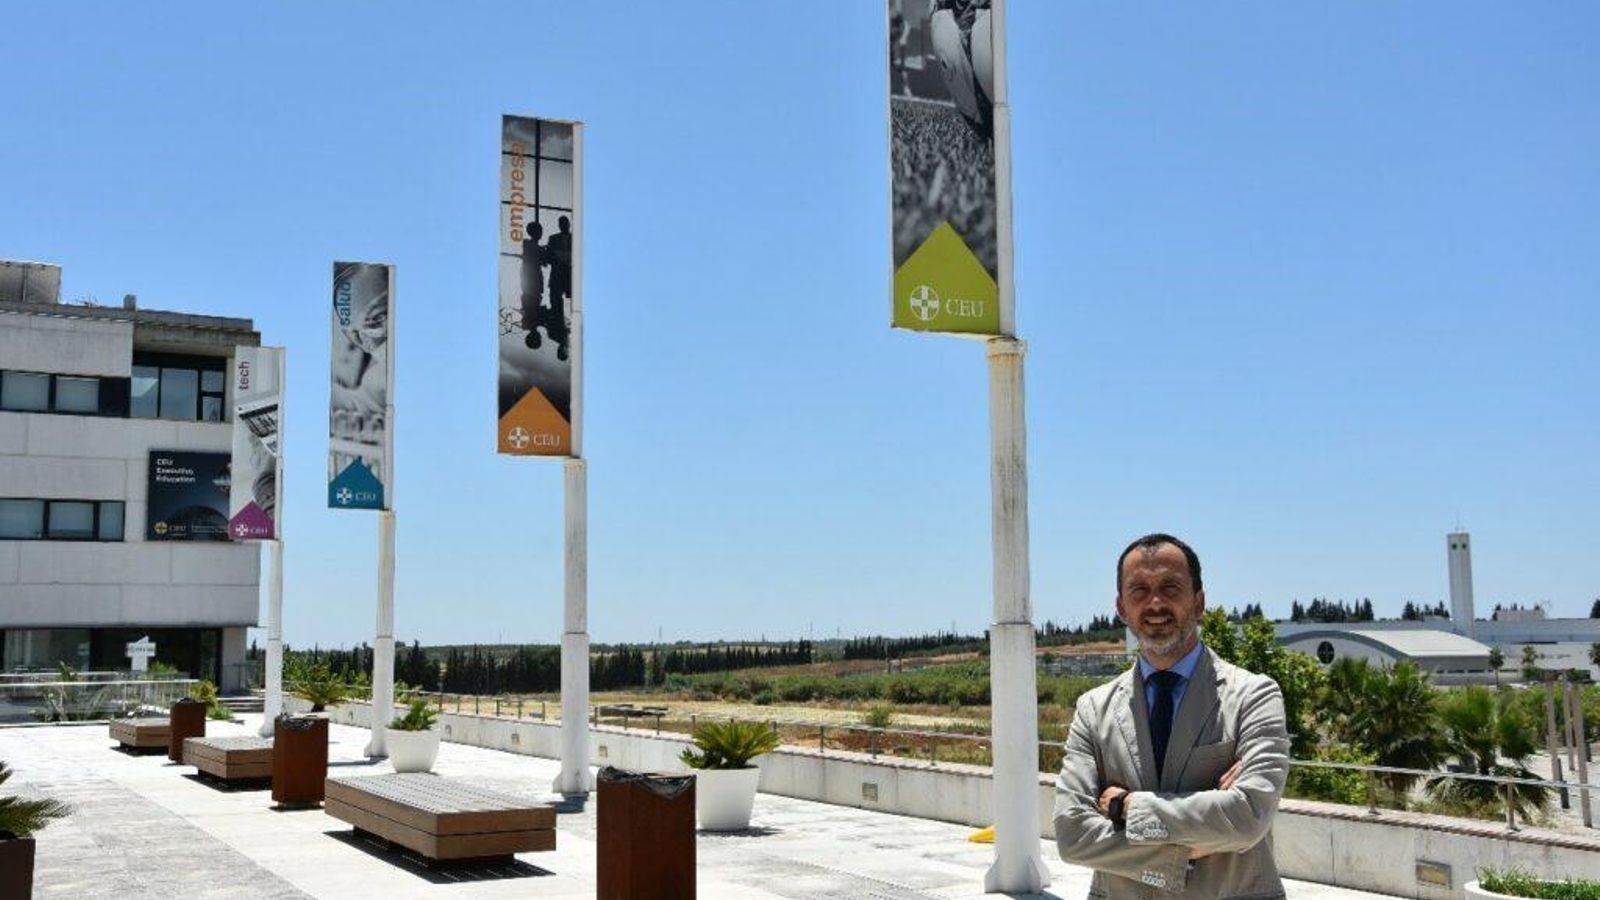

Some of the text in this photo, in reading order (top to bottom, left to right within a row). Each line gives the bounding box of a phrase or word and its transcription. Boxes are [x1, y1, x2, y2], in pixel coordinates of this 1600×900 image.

[510, 143, 526, 242] empresa
[337, 281, 351, 326] salud
[945, 298, 984, 318] CEU
[238, 361, 250, 390] tech
[533, 433, 561, 447] CEU
[156, 458, 174, 466] CEU
[156, 467, 194, 475] Executive
[156, 475, 196, 483] Education
